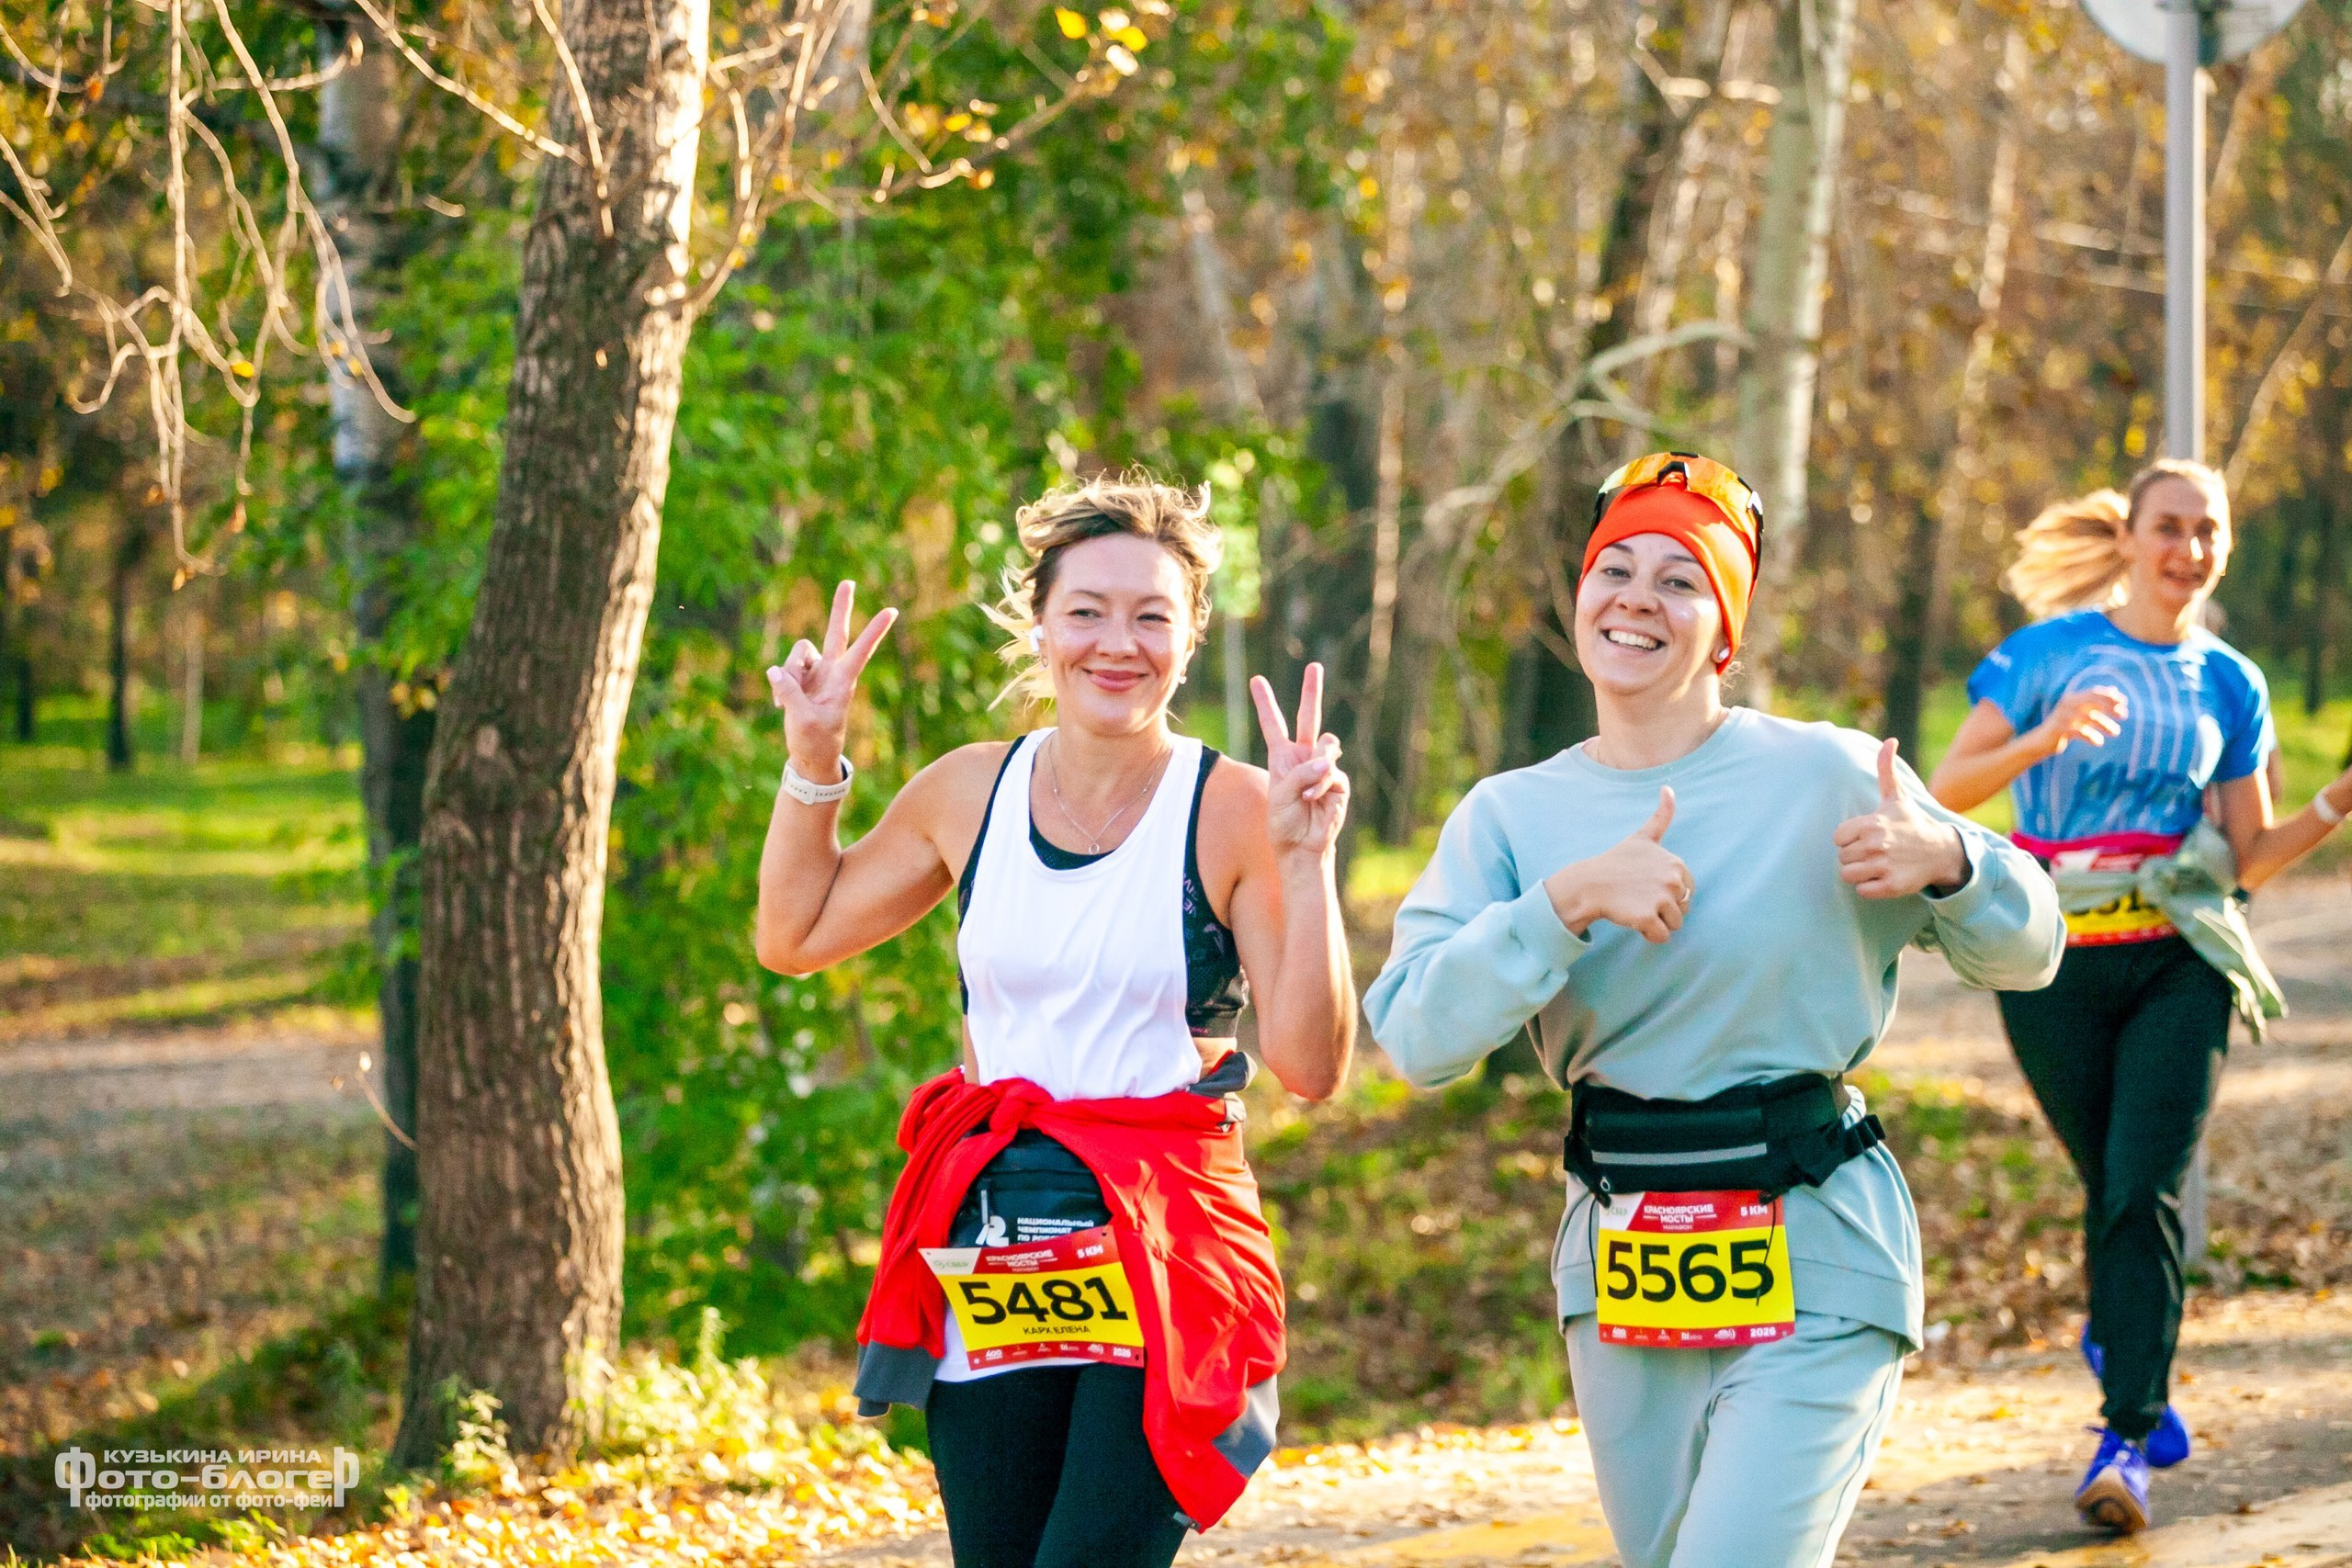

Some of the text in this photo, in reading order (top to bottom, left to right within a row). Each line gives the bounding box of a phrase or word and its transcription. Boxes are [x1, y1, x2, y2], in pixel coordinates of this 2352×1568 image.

[1644, 1203, 1714, 1214] КРАСНОЯРСКИЕ
[1740, 1205, 1768, 1216] 5 КМ
[1017, 1217, 1094, 1227] НАЦИОНАЛЬНЫЙ
[1660, 1213, 1693, 1223] МОСТЫ
[1607, 1238, 1775, 1303] 5565
[958, 1276, 1128, 1325] 5481
[1057, 1325, 1091, 1335] ЕЛЕНА
